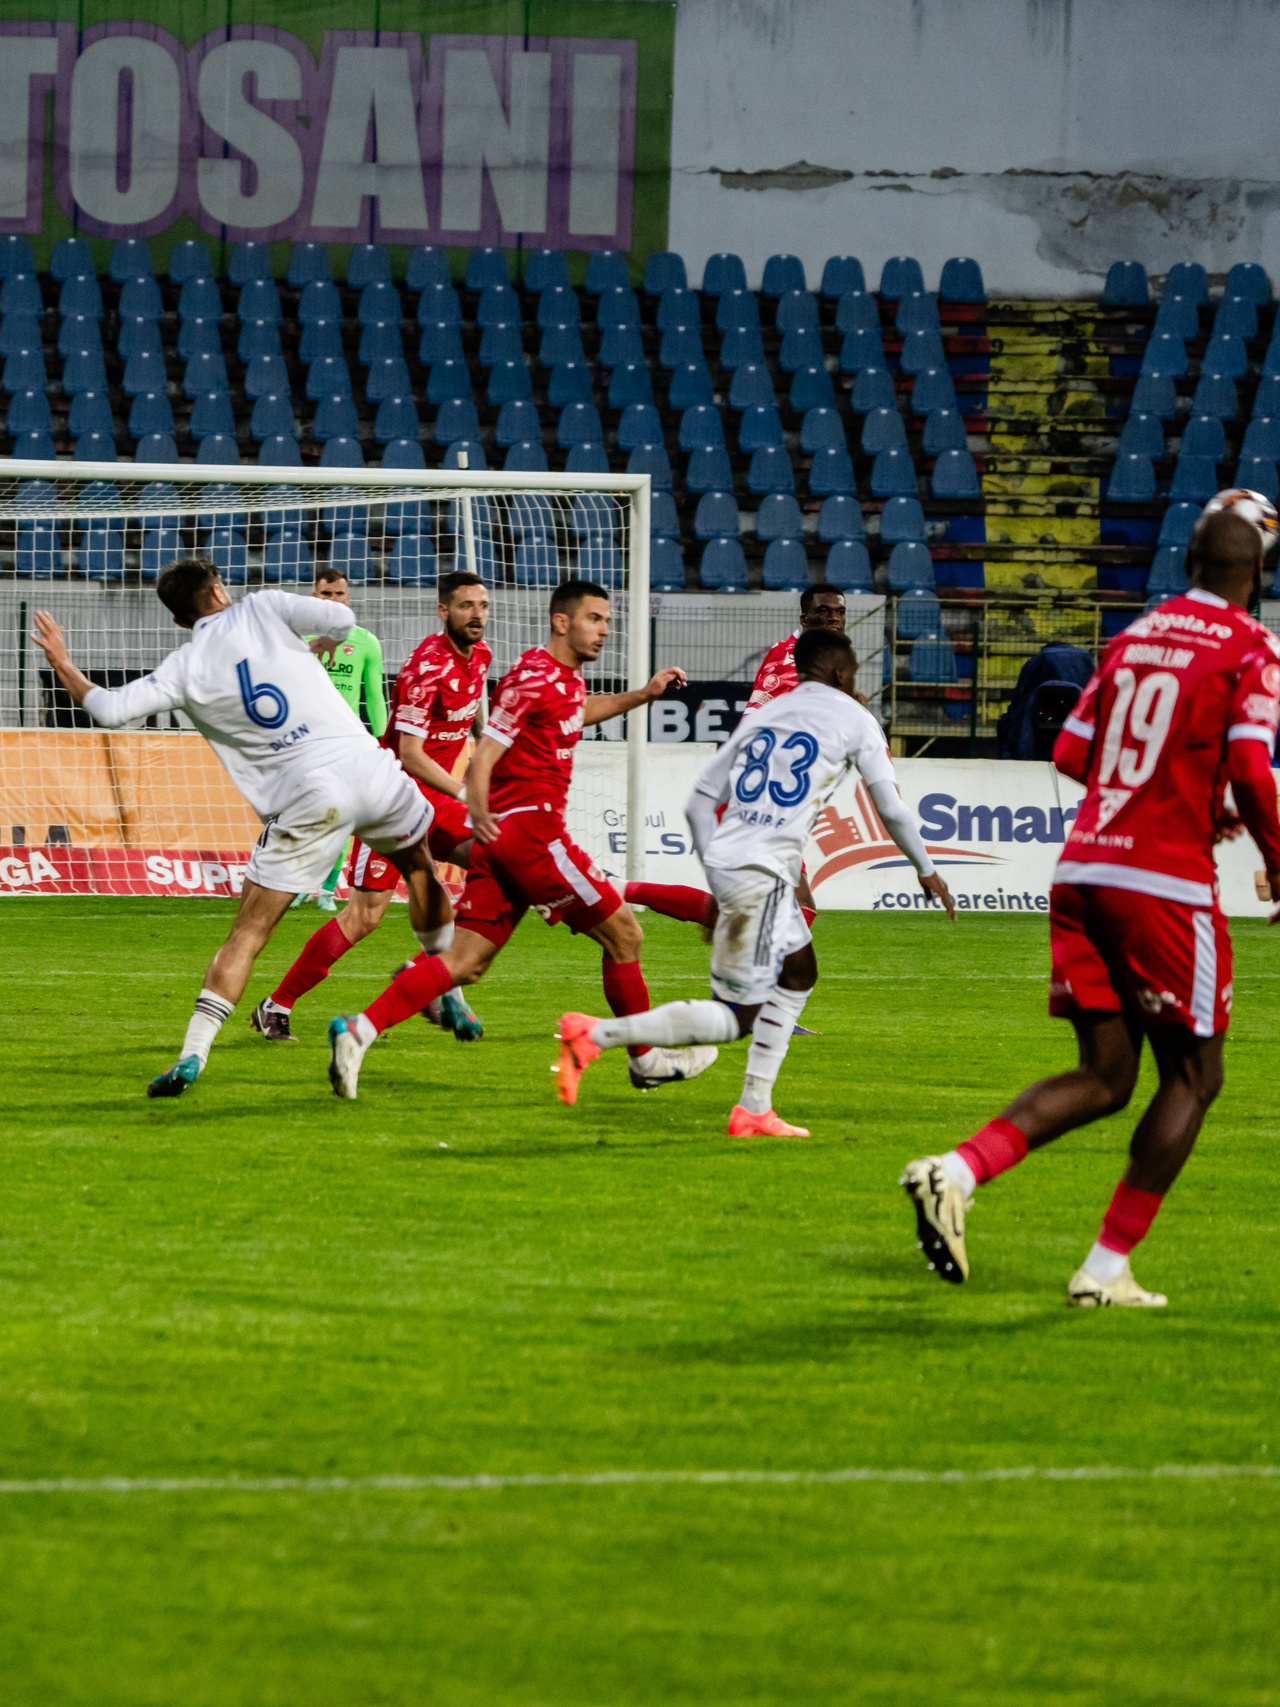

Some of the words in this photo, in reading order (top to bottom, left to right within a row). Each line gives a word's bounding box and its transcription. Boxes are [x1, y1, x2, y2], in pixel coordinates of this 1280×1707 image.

[236, 658, 289, 729] 6
[1098, 668, 1179, 787] 19
[736, 728, 818, 807] 83
[918, 793, 1083, 843] Smar
